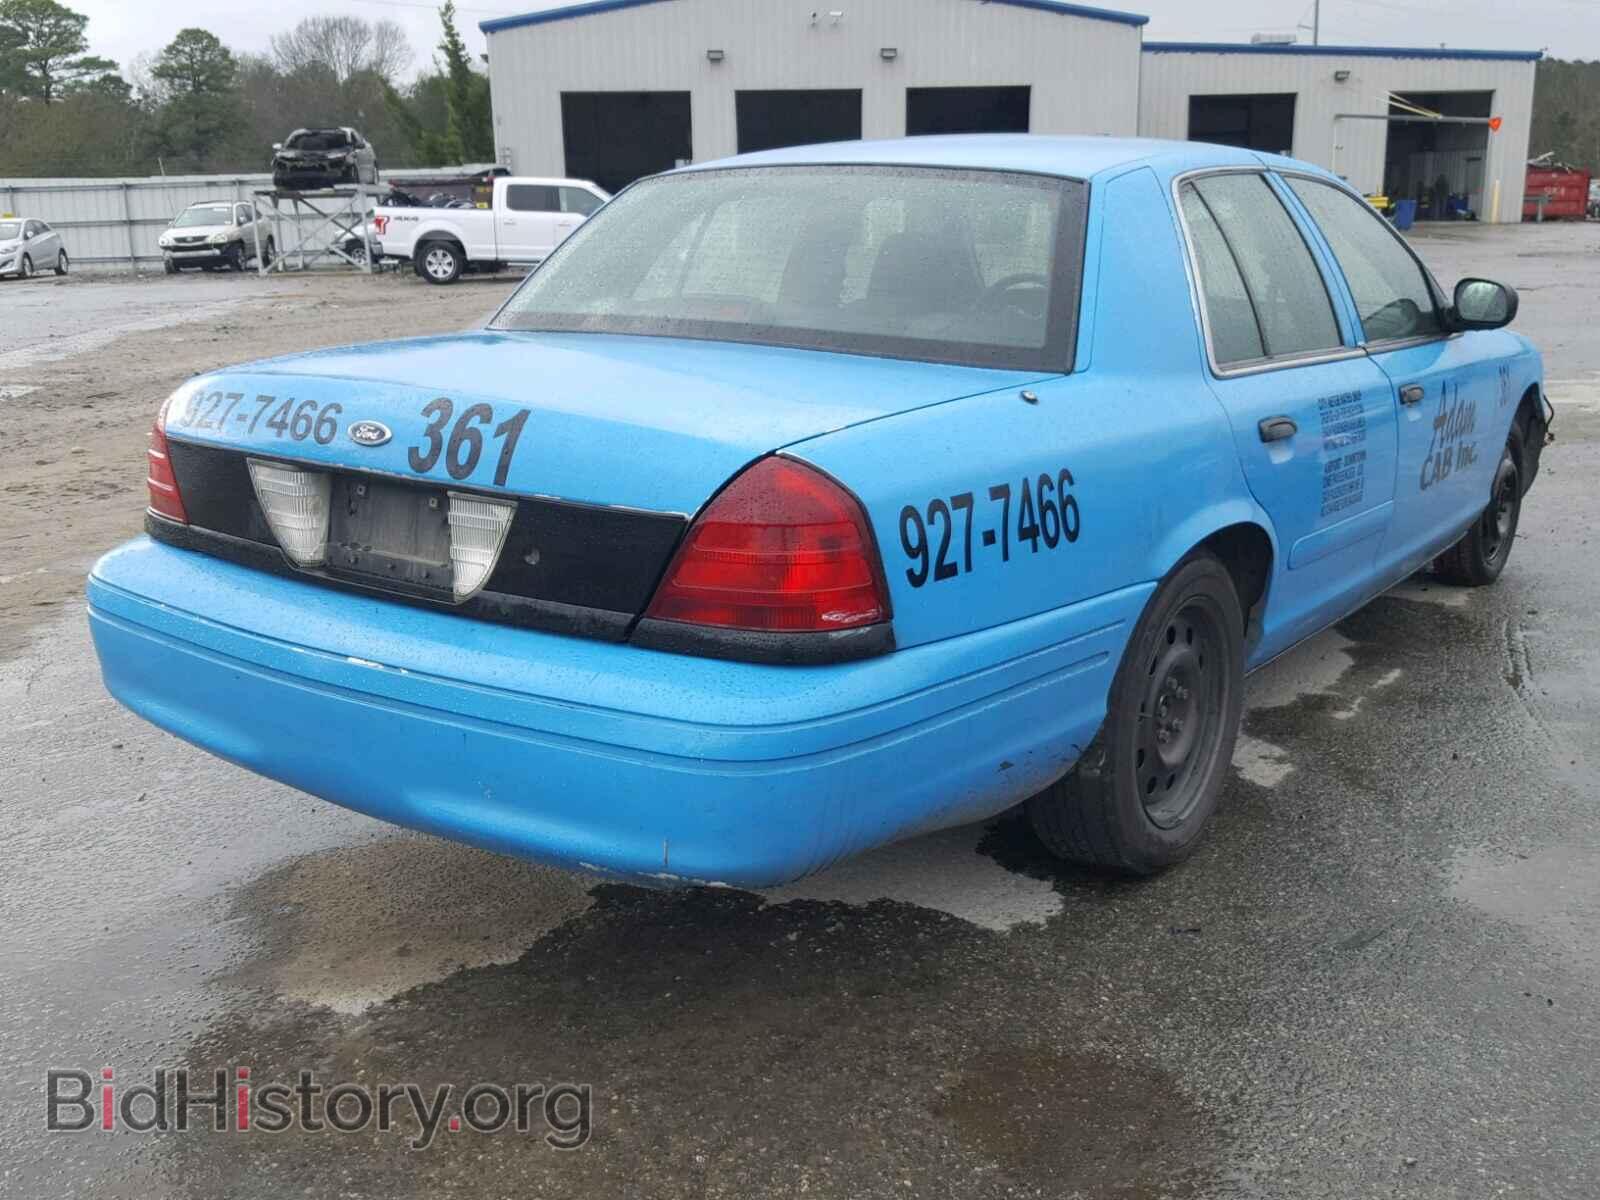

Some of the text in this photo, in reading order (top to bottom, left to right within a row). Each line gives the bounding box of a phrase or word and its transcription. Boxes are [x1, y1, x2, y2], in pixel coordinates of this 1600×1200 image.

[181, 391, 343, 445] 927-7466
[408, 397, 532, 487] 361
[899, 468, 1080, 589] 927-7466
